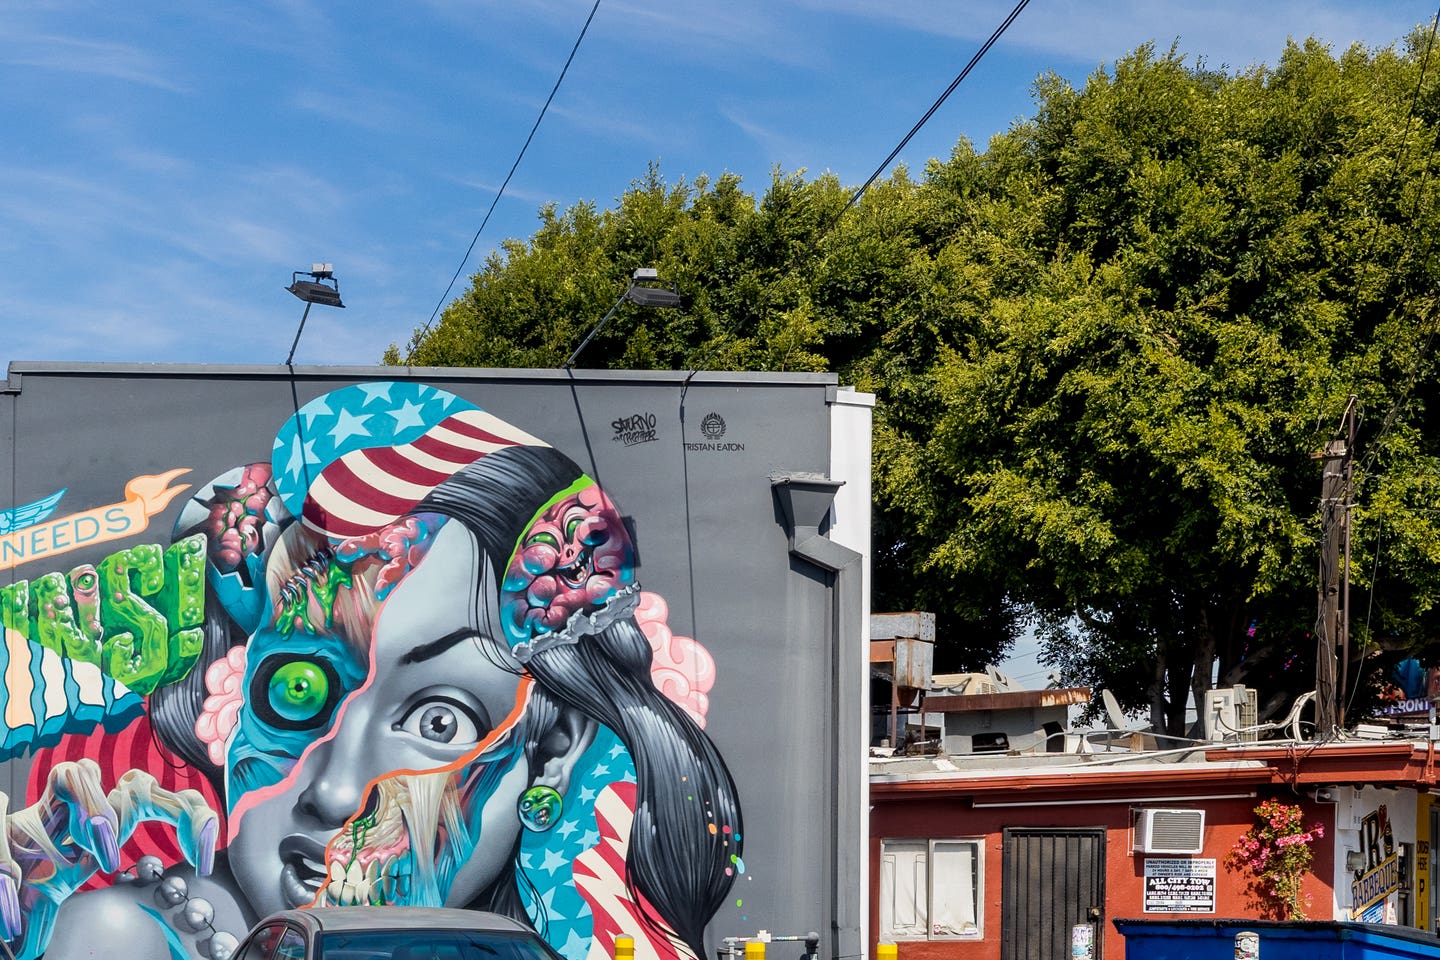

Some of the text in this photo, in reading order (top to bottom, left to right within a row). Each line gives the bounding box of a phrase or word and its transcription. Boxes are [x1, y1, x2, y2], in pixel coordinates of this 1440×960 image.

[683, 443, 745, 451] TRISTAN EATON
[2, 507, 132, 562] NEEDS
[1149, 878, 1167, 886] ALL
[1190, 878, 1210, 886] TOW
[1352, 861, 1397, 913] BARBEQUE
